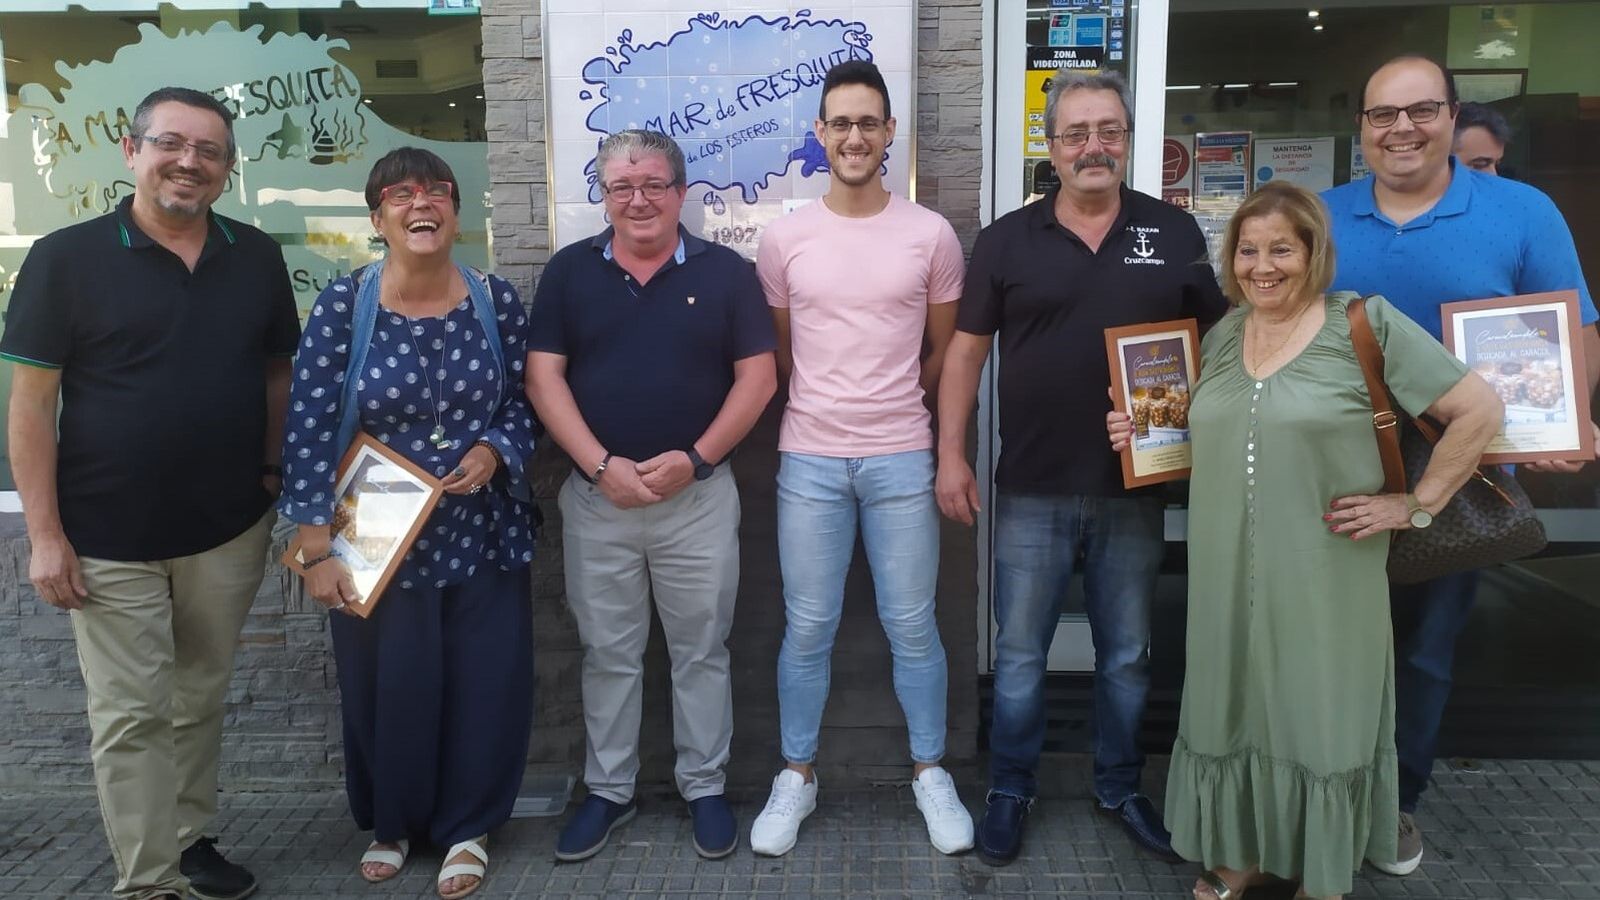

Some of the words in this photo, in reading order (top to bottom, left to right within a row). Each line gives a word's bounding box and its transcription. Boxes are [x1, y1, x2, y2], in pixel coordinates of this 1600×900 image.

[1053, 50, 1077, 59] ZONA
[1033, 60, 1097, 68] VIDEOVIGILADA
[85, 107, 134, 145] MA
[645, 102, 711, 137] MAR
[716, 98, 737, 121] de
[700, 140, 723, 159] LOS
[726, 118, 779, 149] ESTEROS
[1273, 144, 1312, 153] MANTENGA
[712, 226, 757, 244] 1997
